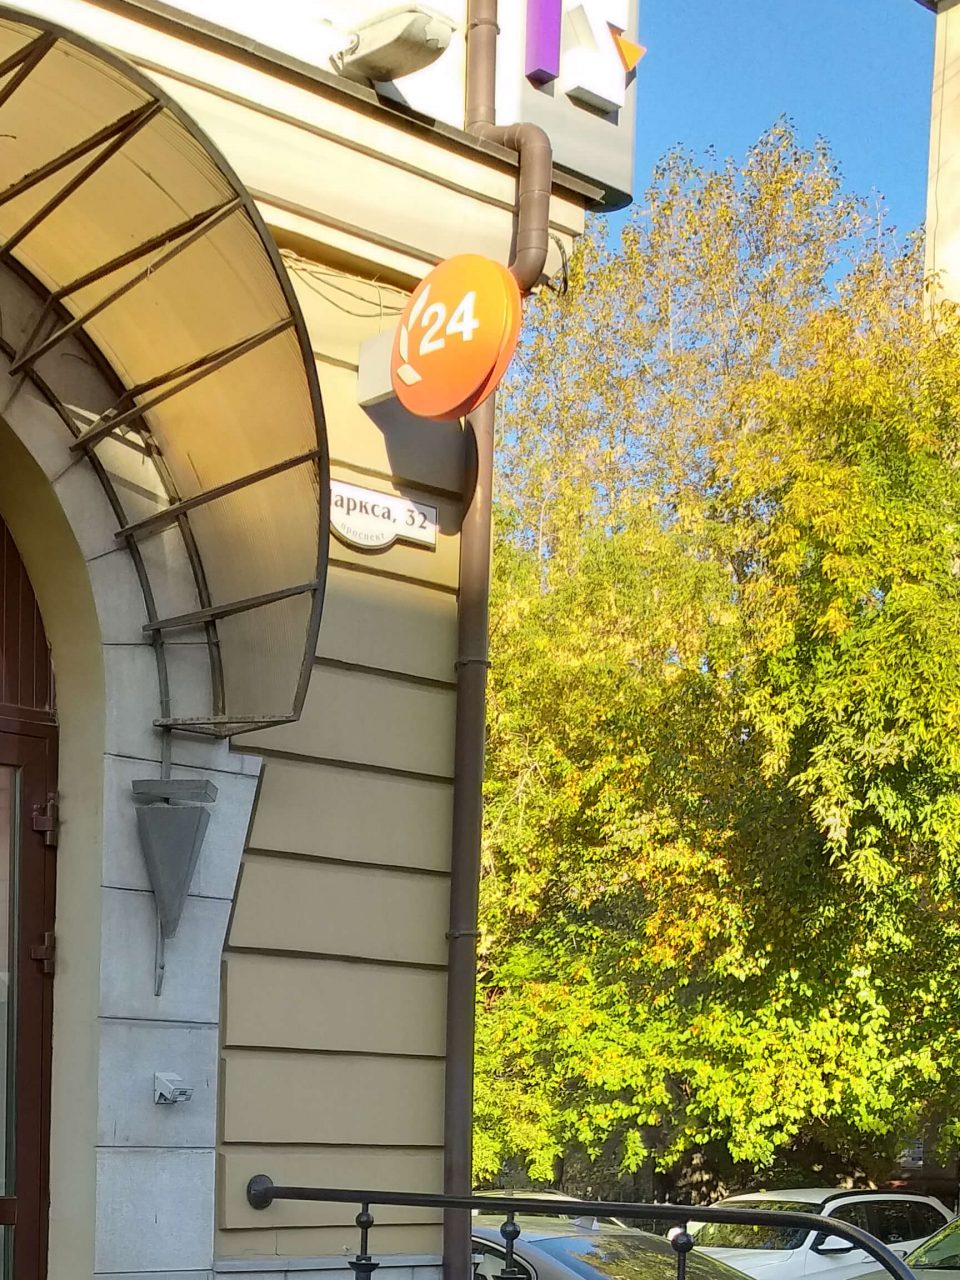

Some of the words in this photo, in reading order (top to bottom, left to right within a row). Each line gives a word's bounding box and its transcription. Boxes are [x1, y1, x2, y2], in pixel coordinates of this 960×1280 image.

[419, 290, 480, 357] 24
[330, 490, 397, 523] аркса,
[405, 508, 427, 529] 32
[340, 522, 385, 541] проспект
